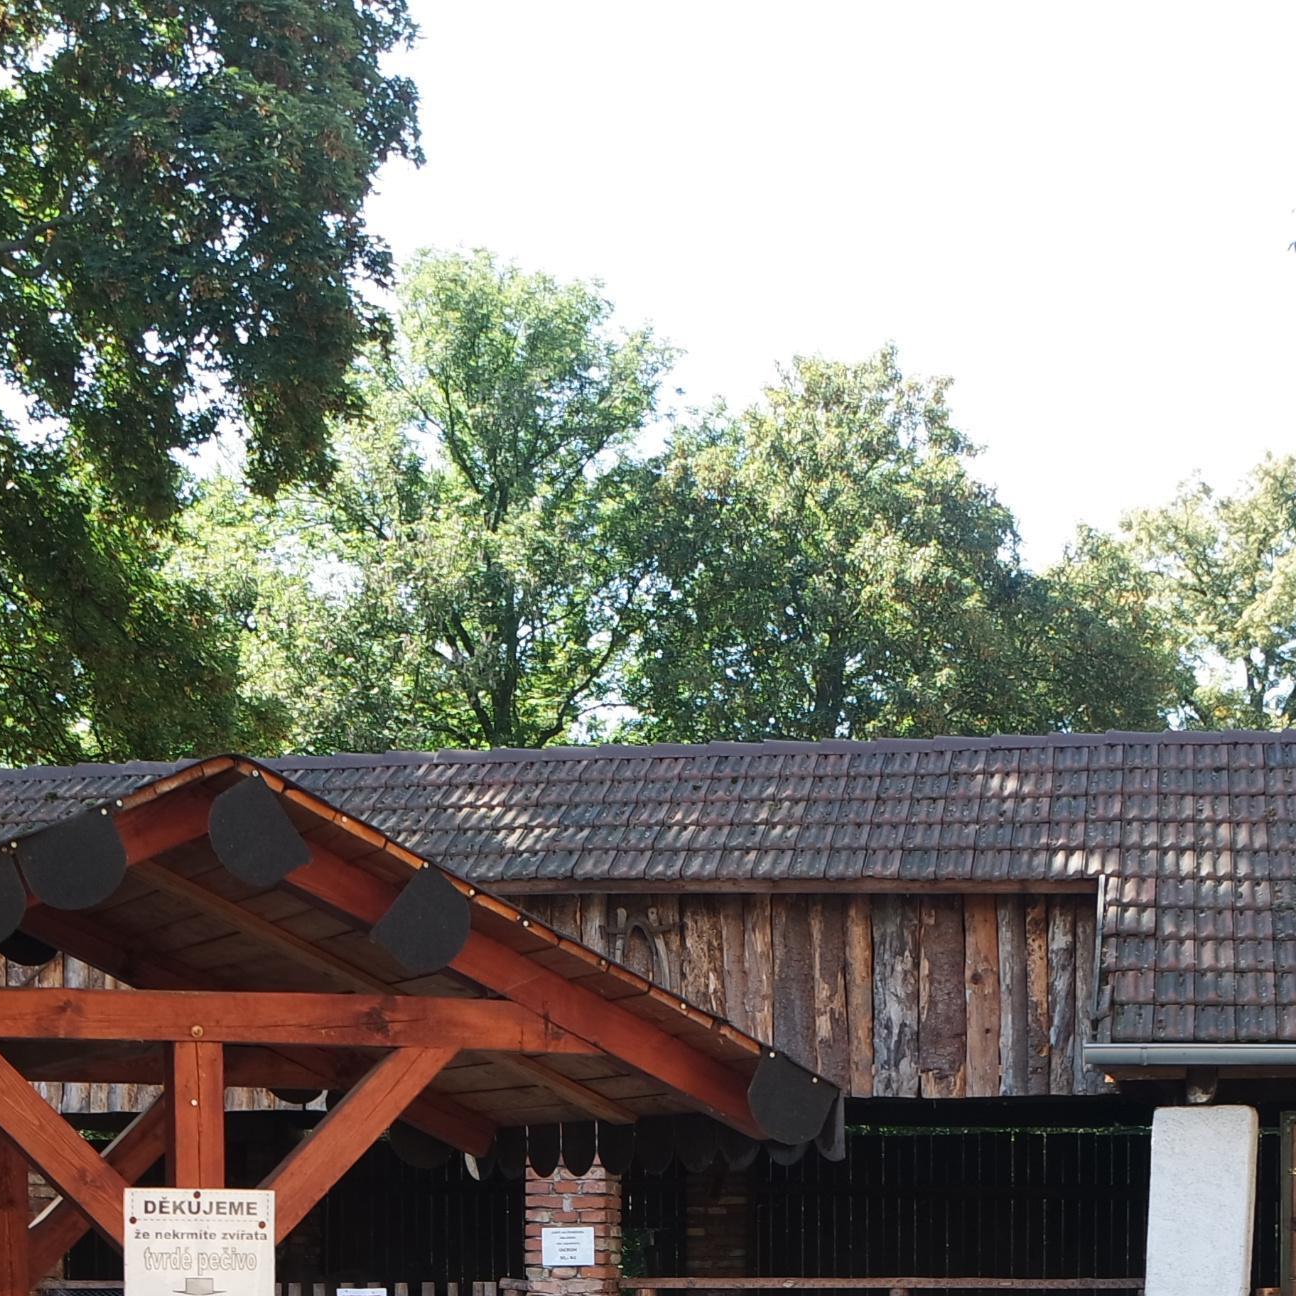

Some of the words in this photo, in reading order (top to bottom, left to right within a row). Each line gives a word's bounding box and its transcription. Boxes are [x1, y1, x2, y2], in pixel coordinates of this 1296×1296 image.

[144, 1196, 258, 1216] DĚKUJEME
[134, 1229, 150, 1240] že
[144, 1246, 193, 1271] tvrdé
[197, 1246, 258, 1277] pečivo
